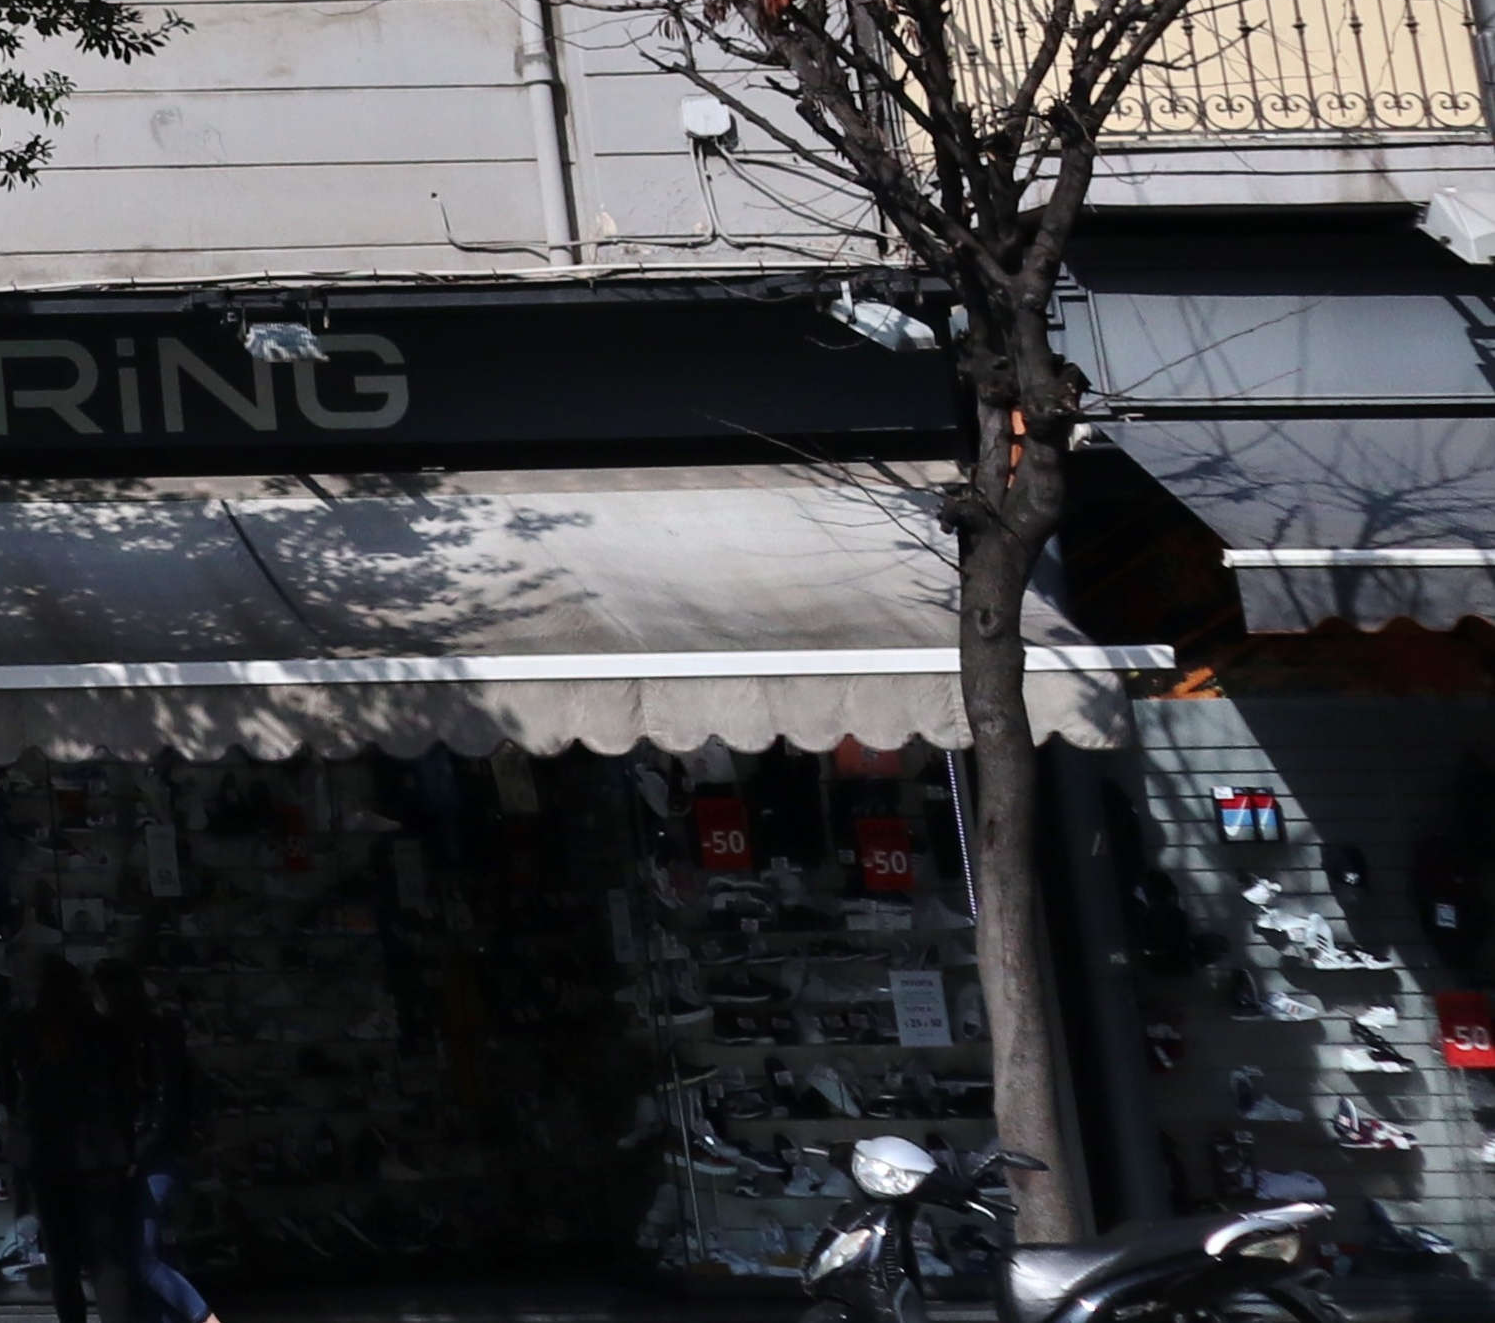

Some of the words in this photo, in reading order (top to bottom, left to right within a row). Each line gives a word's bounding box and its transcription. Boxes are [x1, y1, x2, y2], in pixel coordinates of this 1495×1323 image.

[702, 830, 746, 855] -50
[864, 850, 908, 875] -50
[1443, 1025, 1491, 1052] -50
